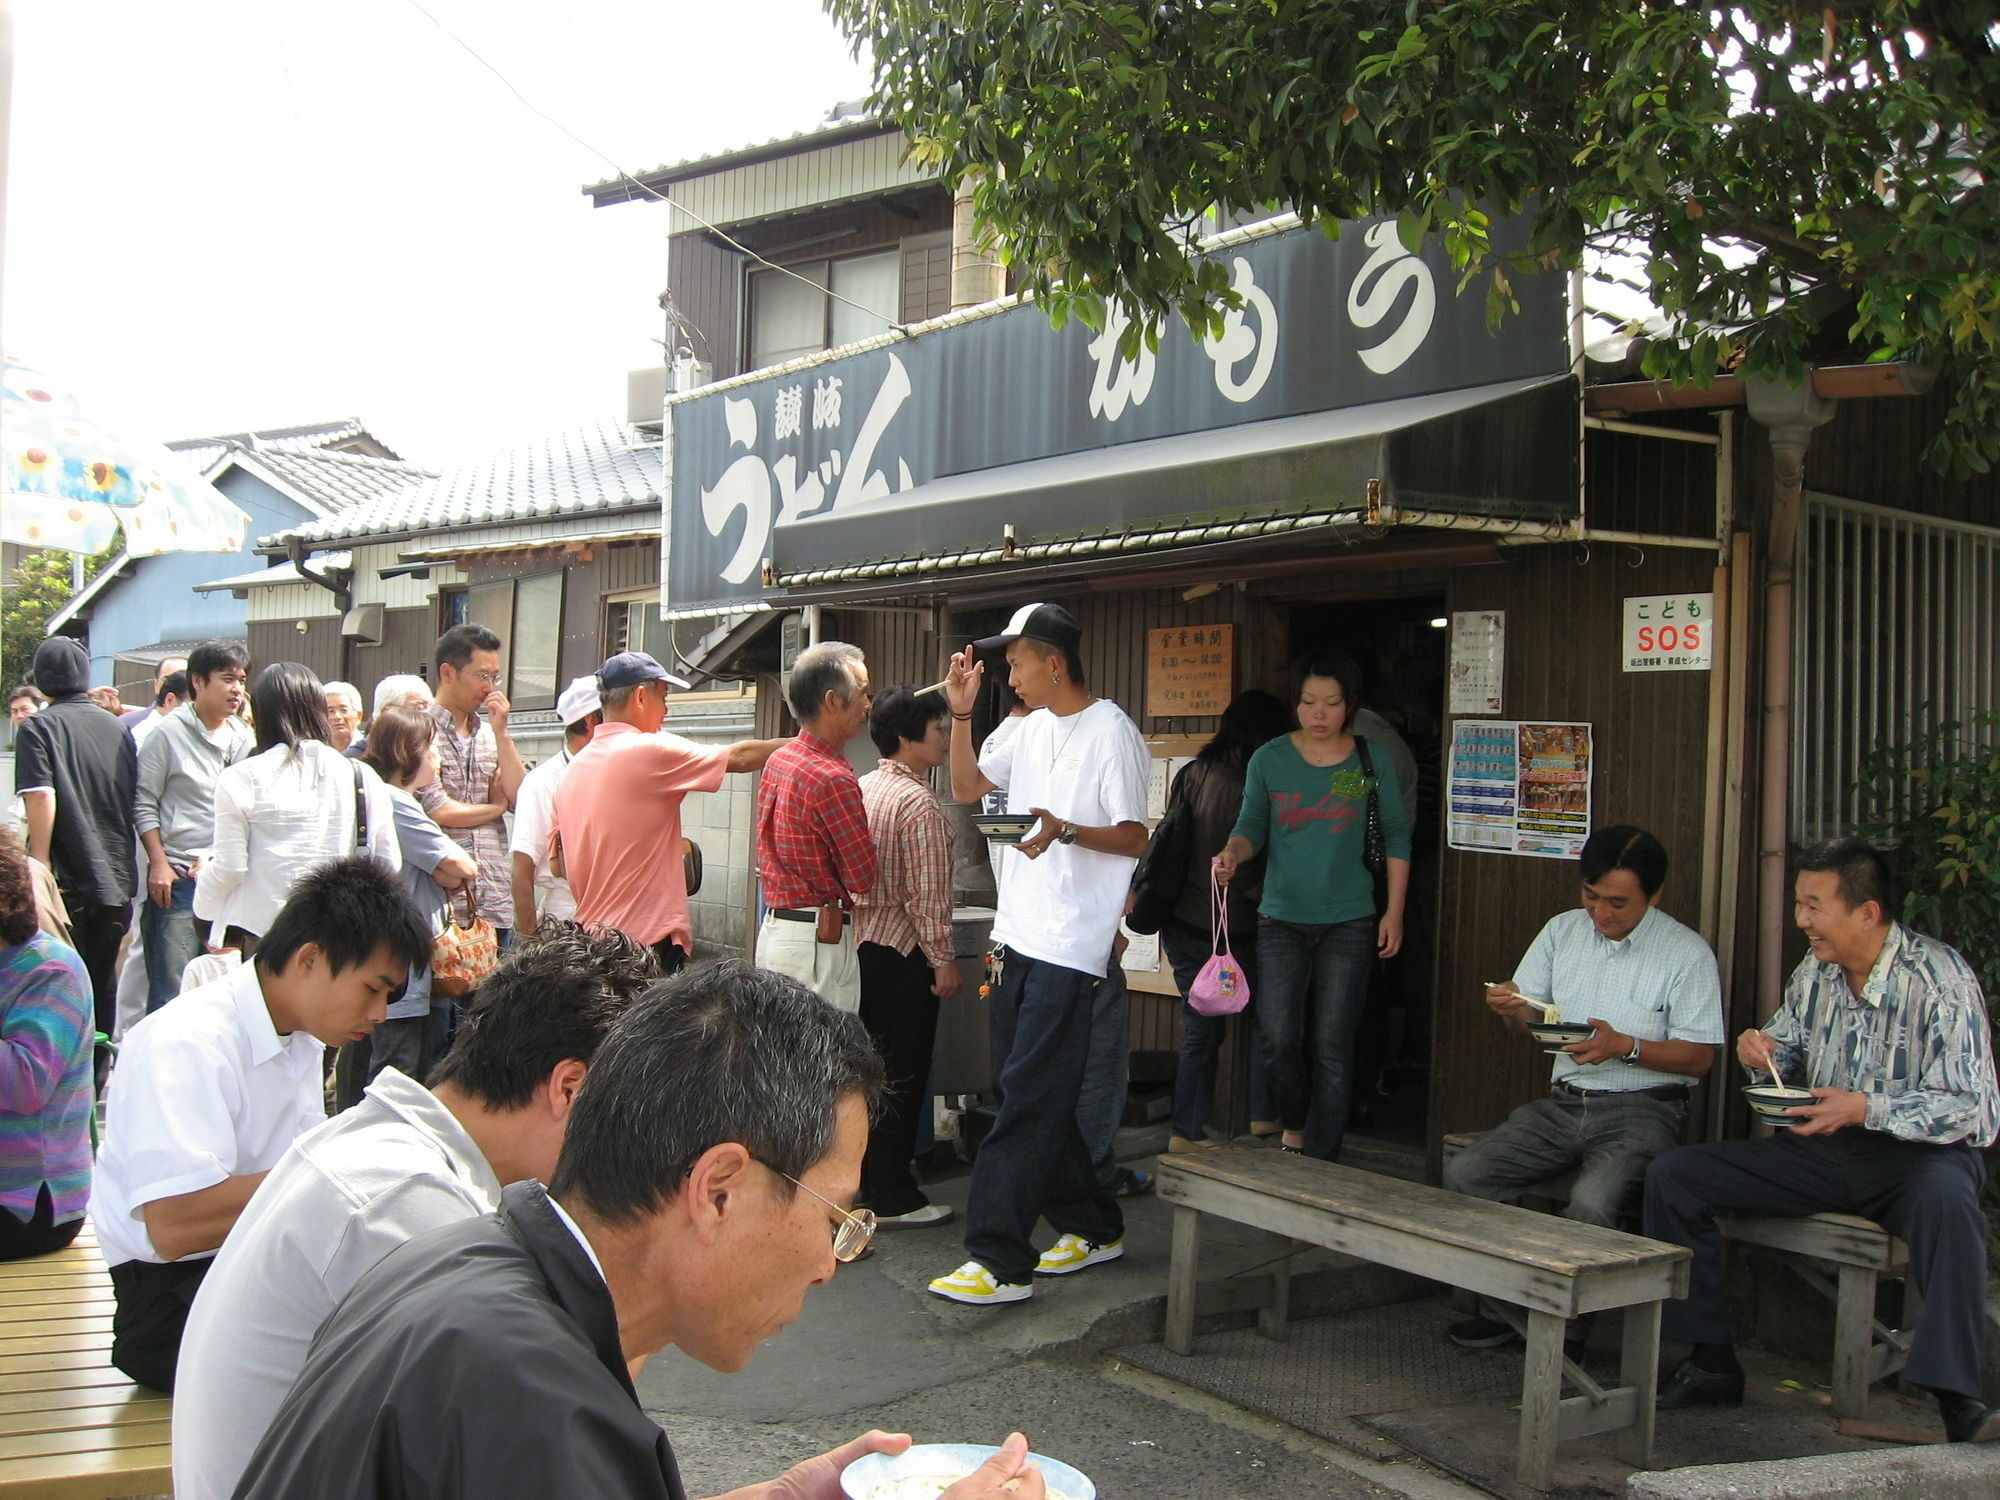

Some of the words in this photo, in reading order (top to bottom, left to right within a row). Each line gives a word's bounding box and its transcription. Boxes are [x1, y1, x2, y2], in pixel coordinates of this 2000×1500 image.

[701, 352, 914, 584] うどん
[1638, 600, 1701, 619] こども
[1161, 629, 1222, 649] 営業時間
[1638, 624, 1701, 652] SOS
